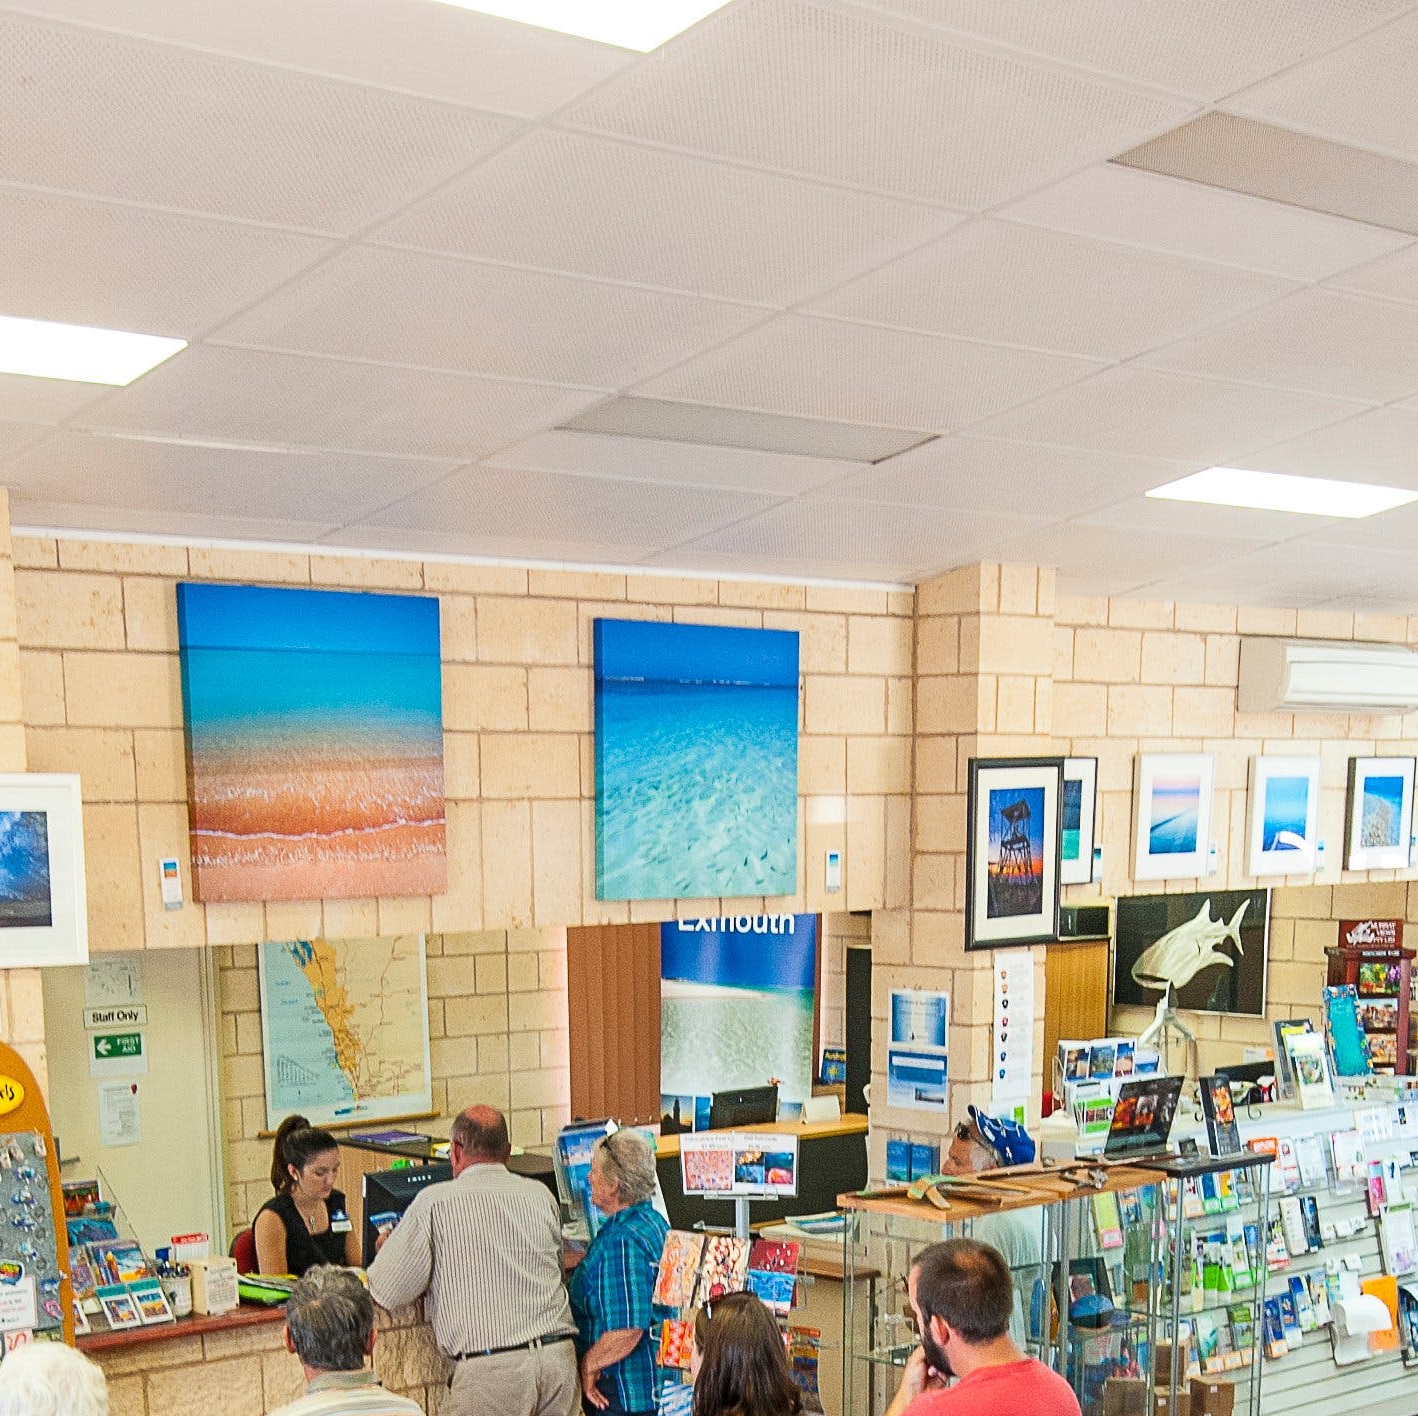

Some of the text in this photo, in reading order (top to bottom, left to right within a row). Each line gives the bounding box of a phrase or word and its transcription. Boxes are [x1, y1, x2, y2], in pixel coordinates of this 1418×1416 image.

[677, 913, 796, 934] Exmouth
[92, 1010, 139, 1023] Staff Only
